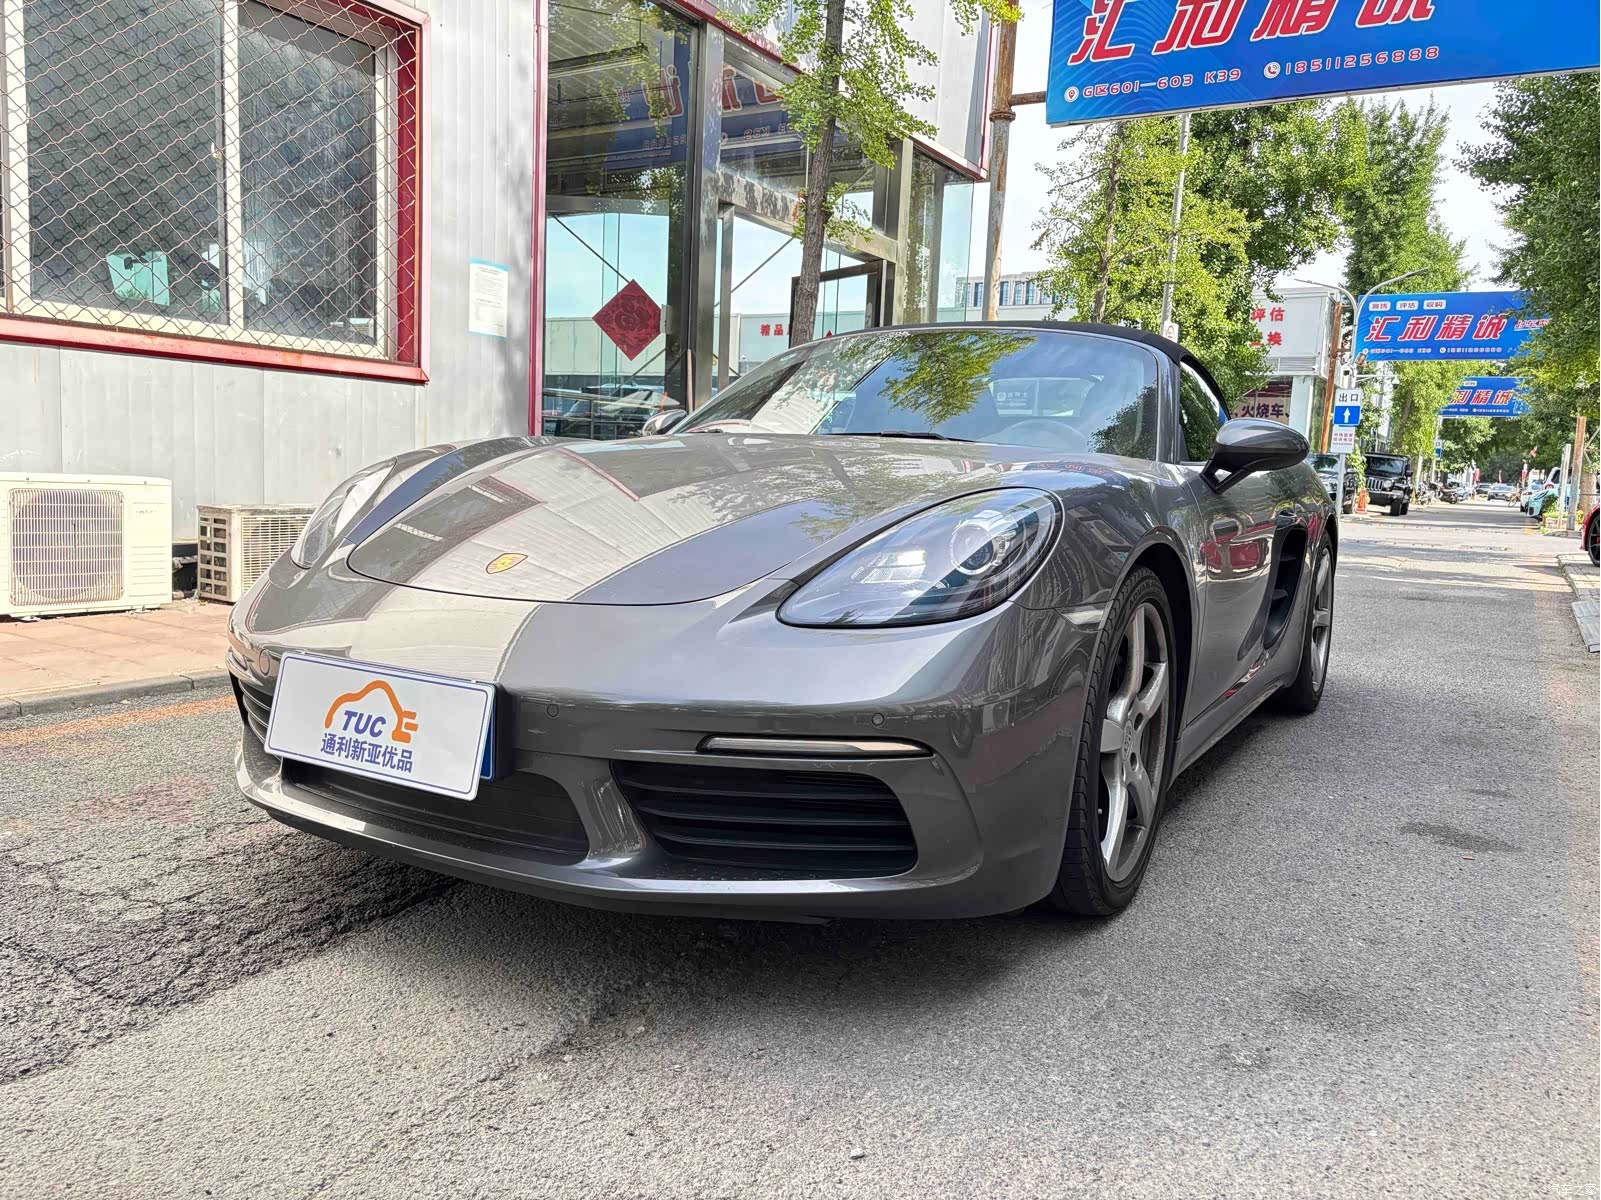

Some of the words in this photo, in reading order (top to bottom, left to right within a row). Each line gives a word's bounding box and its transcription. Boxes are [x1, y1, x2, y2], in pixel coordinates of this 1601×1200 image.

[1204, 69, 1241, 84] K39
[1285, 46, 1439, 75] 18511256888
[1251, 306, 1285, 322] 评估
[760, 323, 790, 336] 精品
[1364, 314, 1509, 342] 汇利精诚
[1339, 392, 1359, 402] 出口
[320, 732, 413, 773] 通利新亚优品
